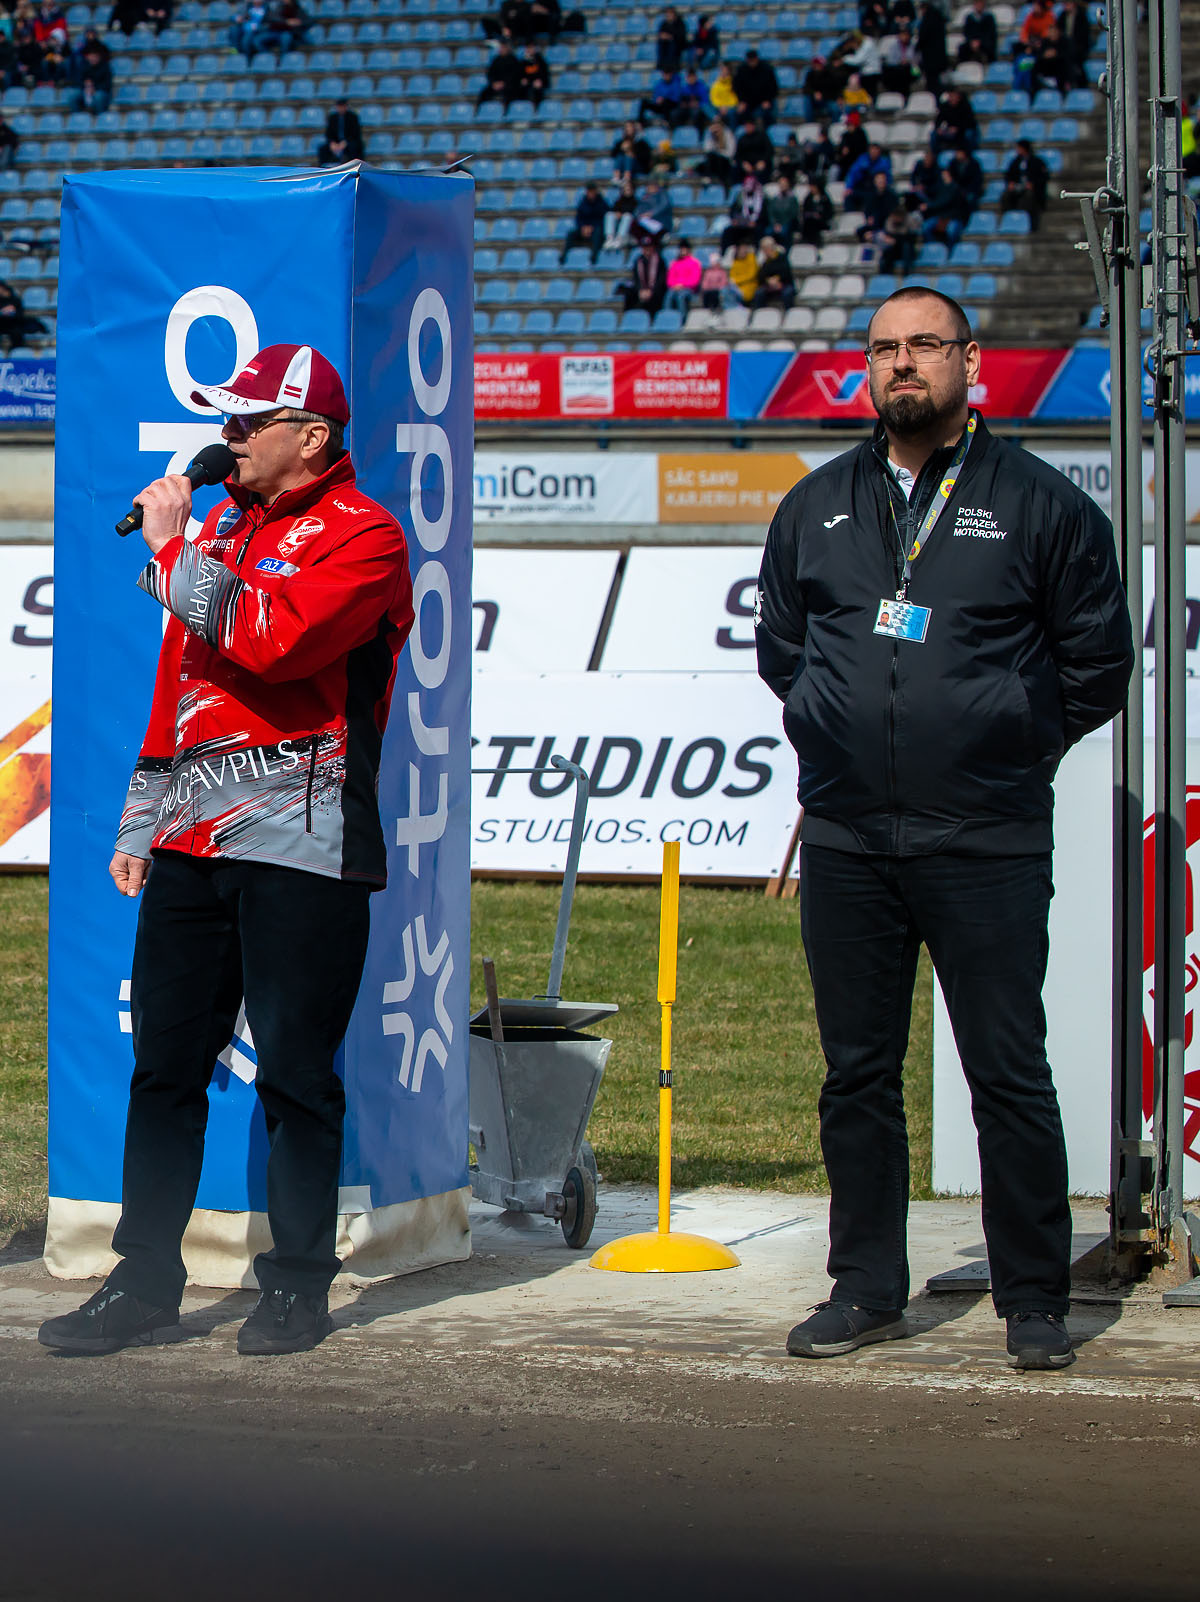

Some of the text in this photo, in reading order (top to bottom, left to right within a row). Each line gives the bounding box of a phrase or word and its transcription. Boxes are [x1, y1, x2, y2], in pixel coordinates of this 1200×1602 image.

[957, 507, 993, 519] POLSKI
[955, 517, 998, 529] ZWIĄZEK
[953, 527, 1008, 540] MOTOROWY
[262, 560, 279, 572] 2LŽ
[397, 288, 453, 879] trodo
[471, 736, 781, 798] TUDIOS
